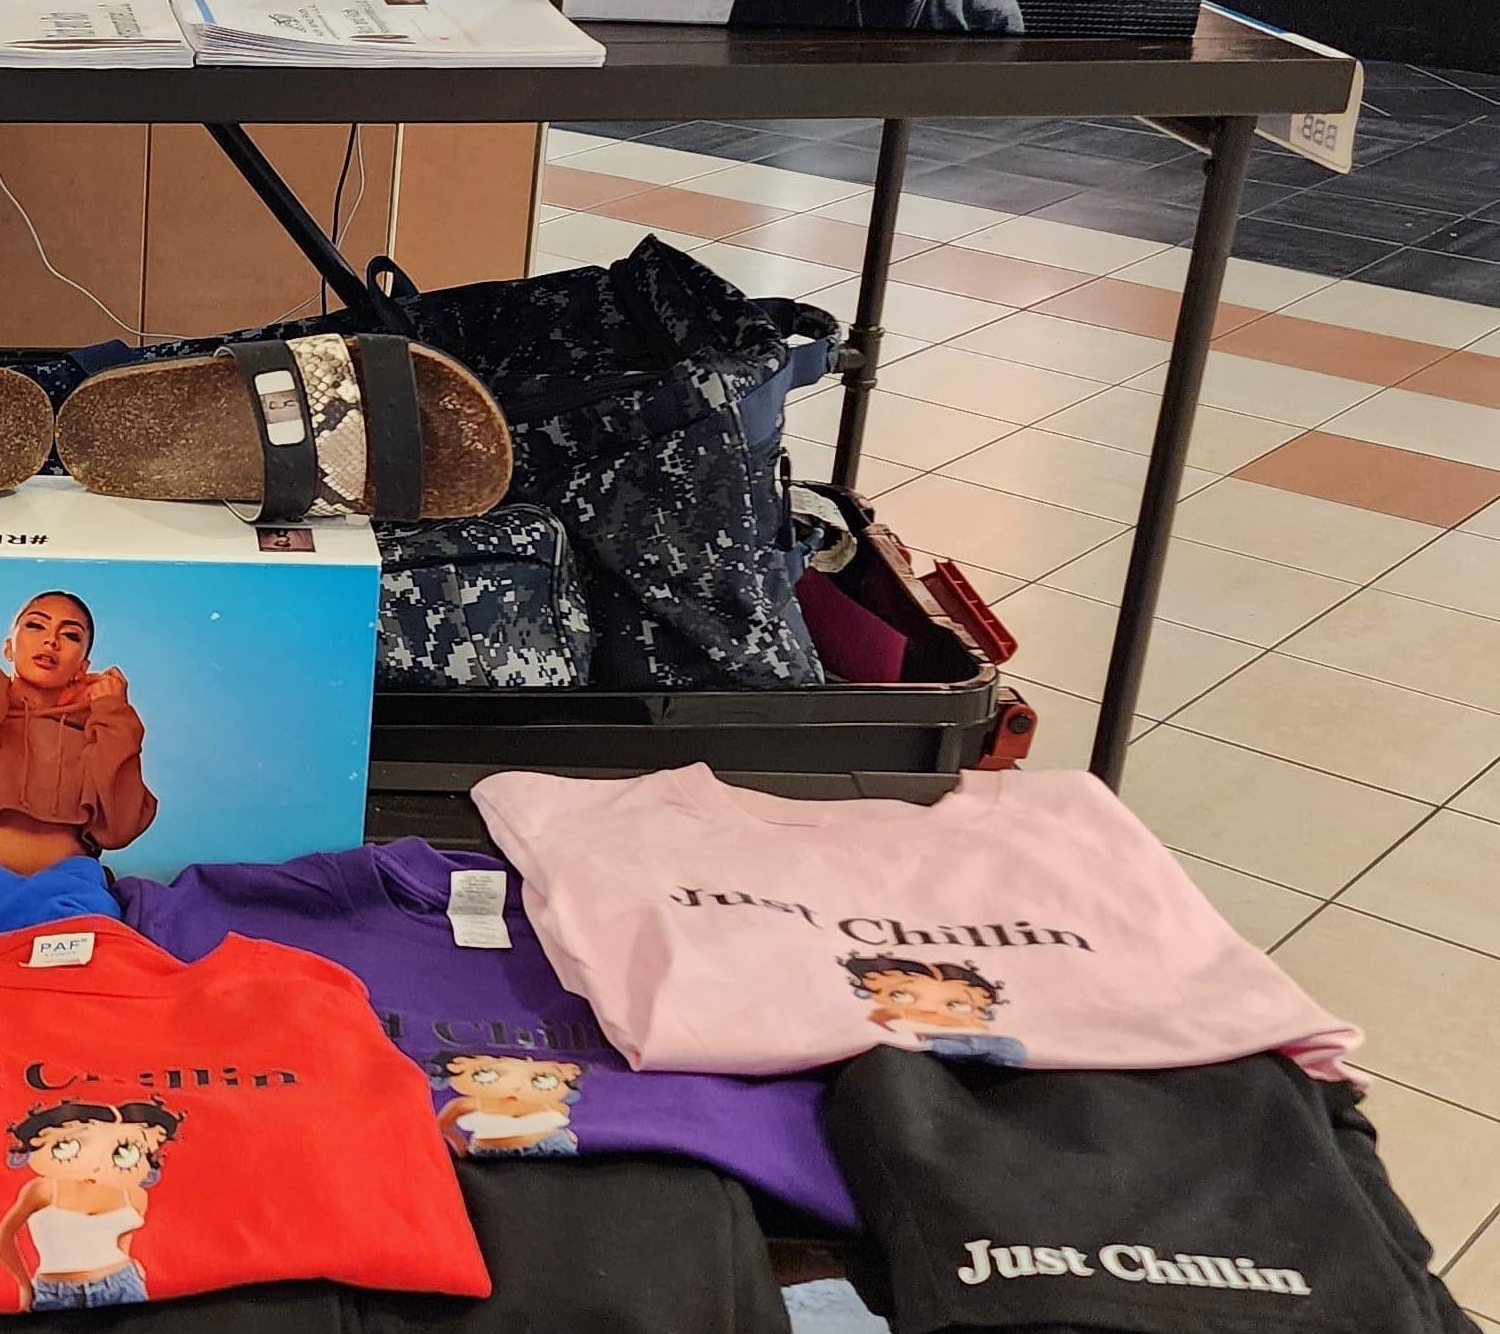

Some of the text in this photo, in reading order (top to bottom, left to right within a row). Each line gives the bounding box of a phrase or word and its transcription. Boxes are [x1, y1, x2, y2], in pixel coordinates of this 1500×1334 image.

[670, 884, 1098, 953] Just Chillin
[957, 1238, 1313, 1296] Just Chillin
